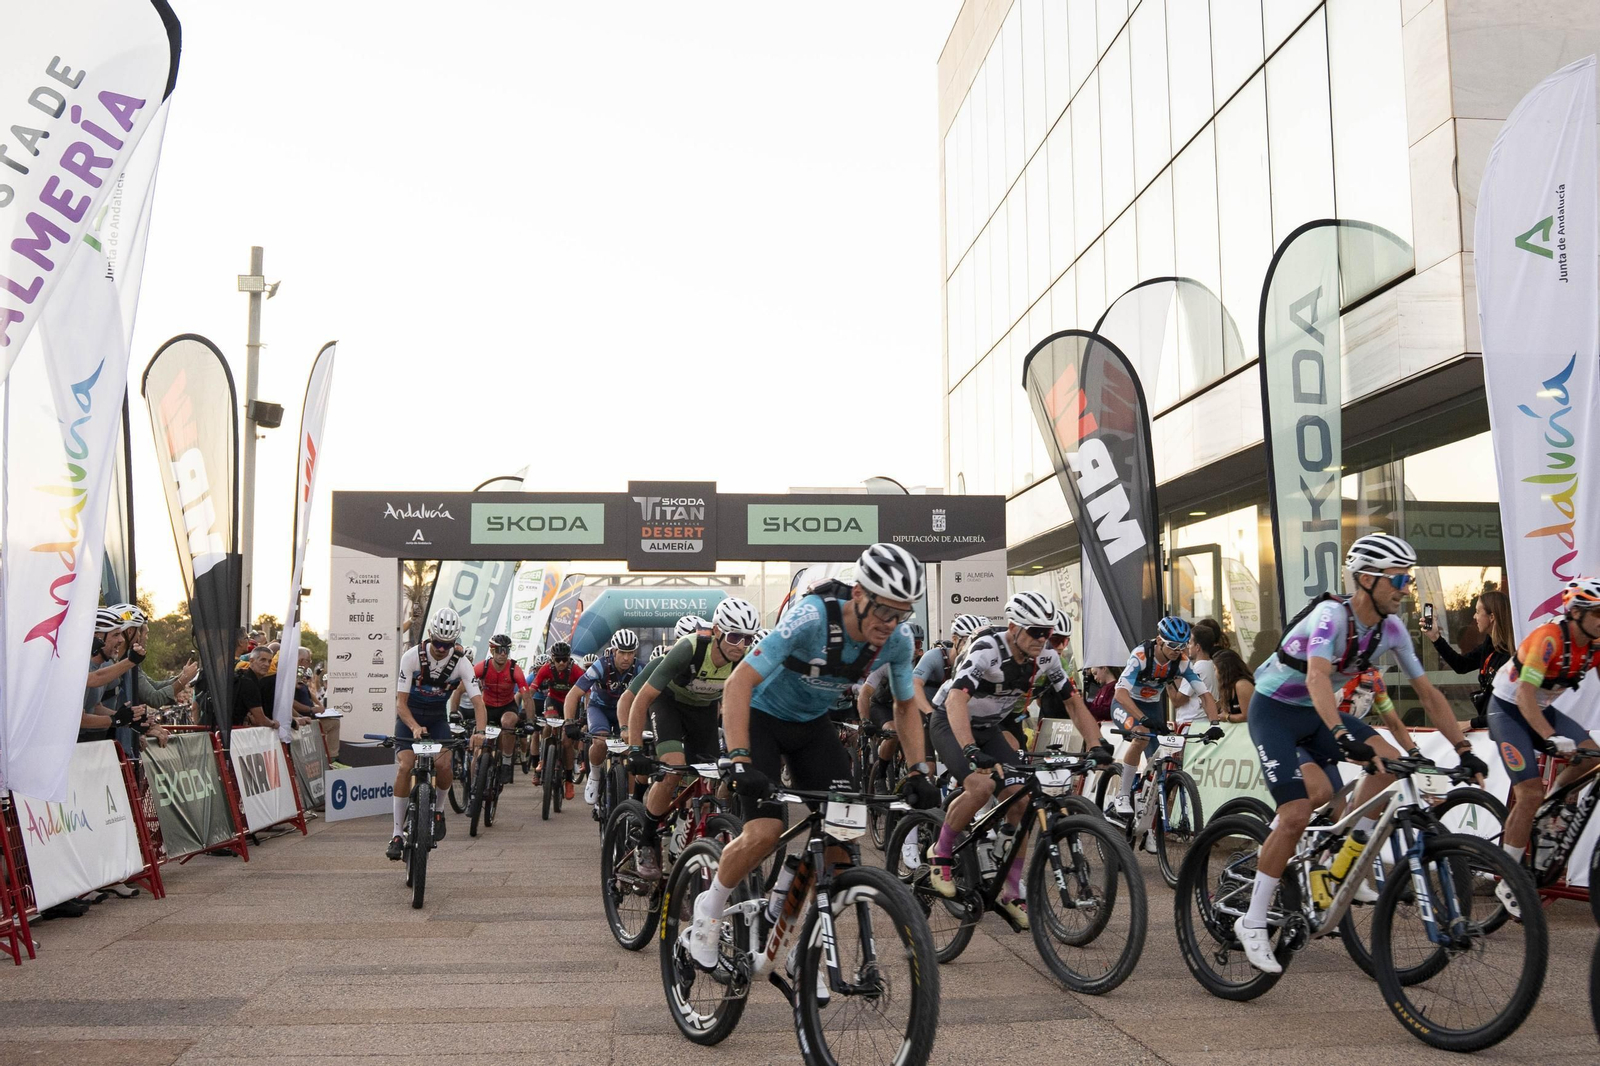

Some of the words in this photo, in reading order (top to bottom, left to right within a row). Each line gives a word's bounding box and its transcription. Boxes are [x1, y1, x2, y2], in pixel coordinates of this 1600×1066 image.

[1556, 183, 1566, 235] Andalucía
[1558, 236, 1566, 250] de
[1559, 252, 1568, 283] Junta
[662, 498, 705, 506] SKODA
[383, 502, 455, 520] Andalucía
[632, 497, 705, 521] TITAN
[486, 516, 588, 532] SKODA
[763, 517, 863, 533] SKODA
[641, 527, 705, 538] DESERT
[892, 535, 940, 543] DIPUTACIÓN
[953, 535, 986, 543] ALMERÍA
[649, 541, 694, 551] ALMERÍA
[624, 598, 707, 610] UNIVERSAE
[654, 610, 685, 618] Superior
[1039, 656, 1052, 665] BH
[1166, 735, 1176, 743] 49
[1049, 771, 1059, 780] 11
[1192, 758, 1270, 791] SKODA
[1425, 775, 1432, 786] 3
[154, 767, 217, 807] SKODA
[1004, 777, 1025, 786] BH
[350, 782, 394, 801] Clearde
[27, 789, 93, 847] Andalucía
[845, 805, 850, 818] 1
